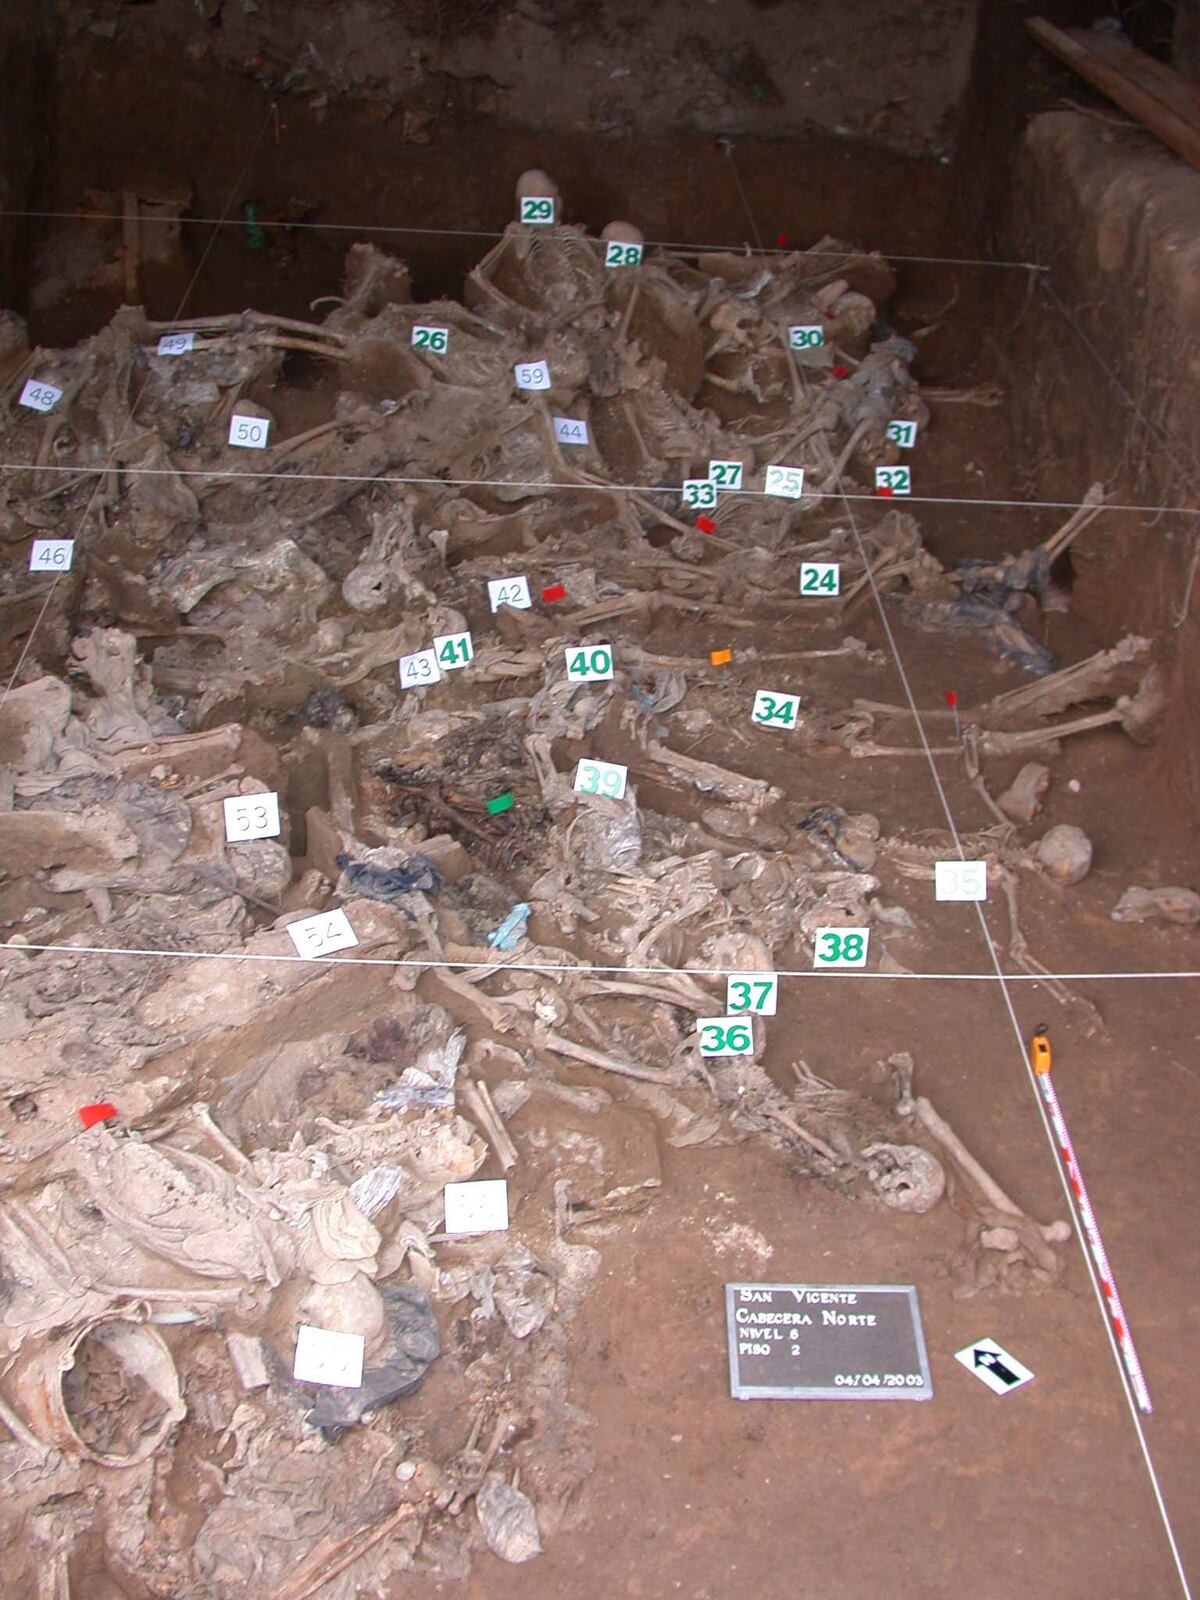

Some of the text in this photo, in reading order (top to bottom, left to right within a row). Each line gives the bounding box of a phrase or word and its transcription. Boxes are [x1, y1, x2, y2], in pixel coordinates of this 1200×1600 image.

[524, 200, 553, 220] 29
[609, 245, 640, 266] 28
[415, 331, 445, 350] 26
[792, 329, 824, 347] 30
[521, 367, 544, 384] 59
[29, 388, 54, 406] 48
[238, 424, 262, 441] 50
[559, 425, 582, 439] 44
[888, 423, 911, 444] 31
[712, 464, 741, 484] 27
[769, 470, 800, 492] 25
[877, 469, 909, 489] 32
[685, 484, 715, 506] 33
[39, 548, 65, 565] 46
[803, 568, 837, 592] 24
[497, 584, 523, 603] 42
[440, 637, 470, 664] 41
[407, 659, 432, 678] 43
[568, 649, 611, 675] 40
[755, 697, 794, 725] 34
[580, 766, 622, 798] 39
[237, 806, 268, 831] 53
[940, 867, 981, 896] 35
[819, 933, 863, 962] 38
[729, 981, 773, 1011] 37
[700, 1024, 751, 1052] 36
[739, 1328, 799, 1340] NIVEL 6
[739, 1343, 801, 1356] PISO 2
